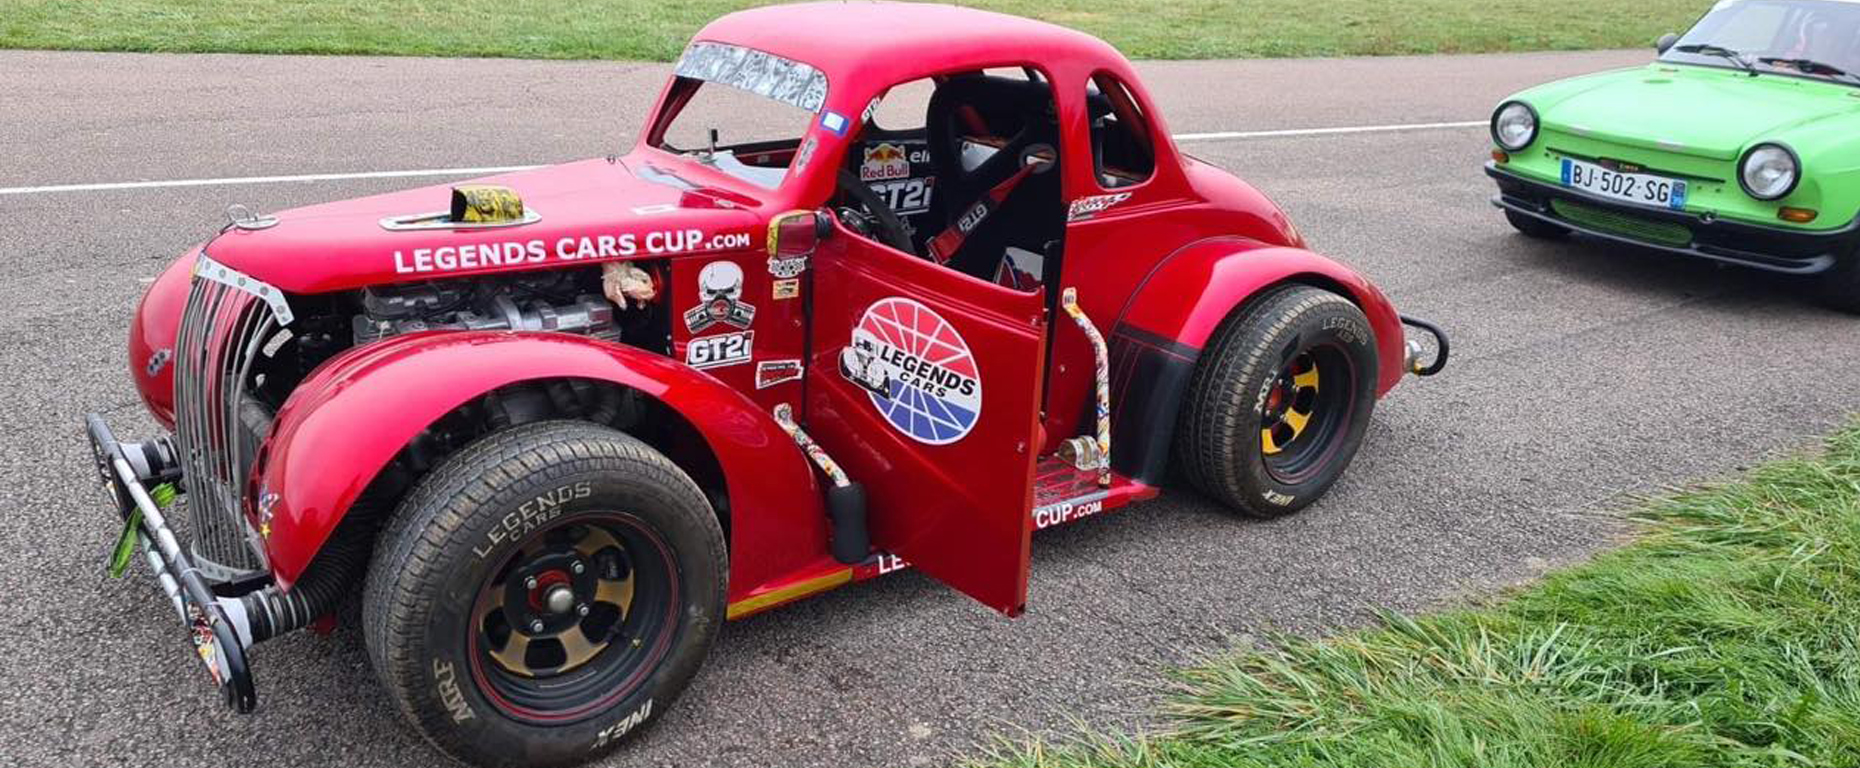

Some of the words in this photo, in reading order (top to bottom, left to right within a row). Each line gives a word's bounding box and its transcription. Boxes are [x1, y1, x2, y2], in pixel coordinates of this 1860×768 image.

[862, 166, 885, 179] Red
[886, 164, 909, 178] Bull
[1573, 165, 1669, 203] BJ-502-SG
[394, 238, 546, 273] LEGENDS
[556, 233, 637, 260] CARS
[689, 332, 753, 364] GT2i
[880, 345, 976, 396] LEGENDS
[899, 372, 947, 398] CARS
[472, 481, 592, 559] LEGENDS
[509, 507, 562, 543] CARS
[434, 658, 477, 724] MRF
[591, 698, 653, 750] INEX
